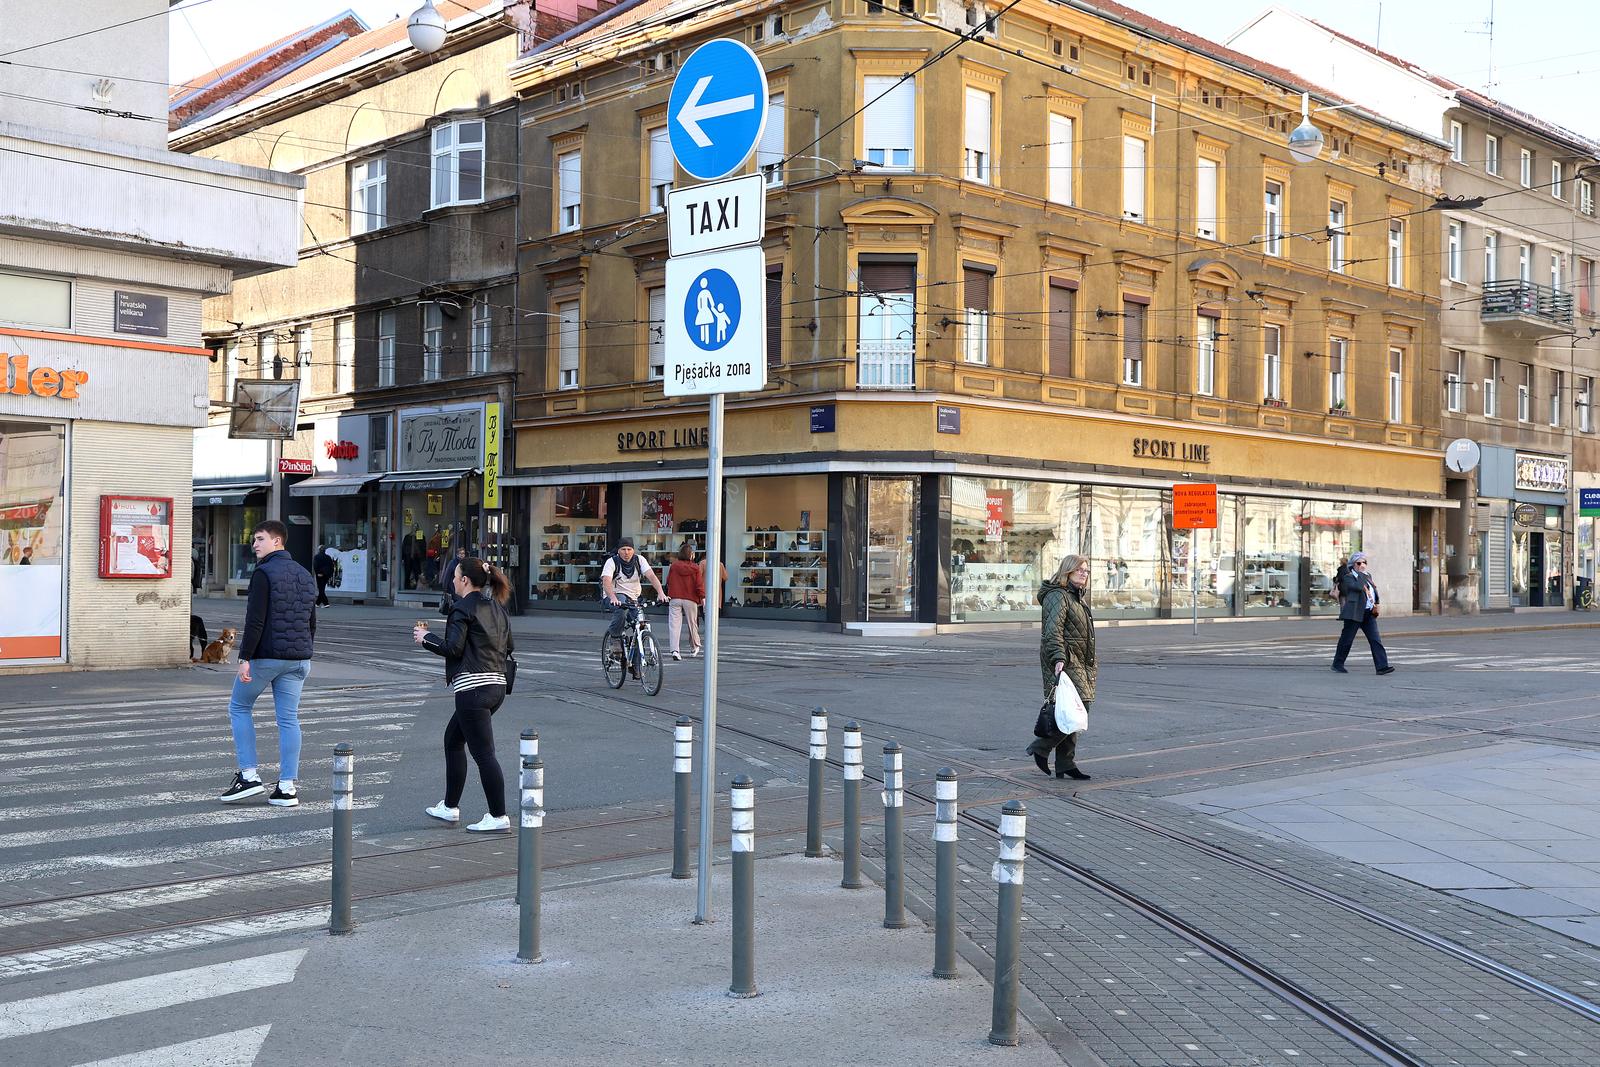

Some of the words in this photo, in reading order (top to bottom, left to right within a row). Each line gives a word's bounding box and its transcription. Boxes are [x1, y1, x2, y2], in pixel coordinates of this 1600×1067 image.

[686, 195, 739, 236] TAXI
[120, 300, 147, 309] hrvatskih
[120, 308, 144, 317] velikana
[675, 361, 721, 385] Pješačka
[726, 362, 751, 377] zona
[488, 415, 497, 443] By
[617, 430, 666, 450] SPORT
[673, 427, 709, 448] LINE
[417, 429, 438, 463] By
[440, 425, 477, 451] Moda
[1133, 437, 1177, 458] SPORT
[1182, 443, 1211, 461] LINE
[280, 460, 312, 472] Vindija
[658, 492, 674, 501] POPUST
[986, 497, 1003, 506] POPUST
[657, 513, 674, 529] -50%
